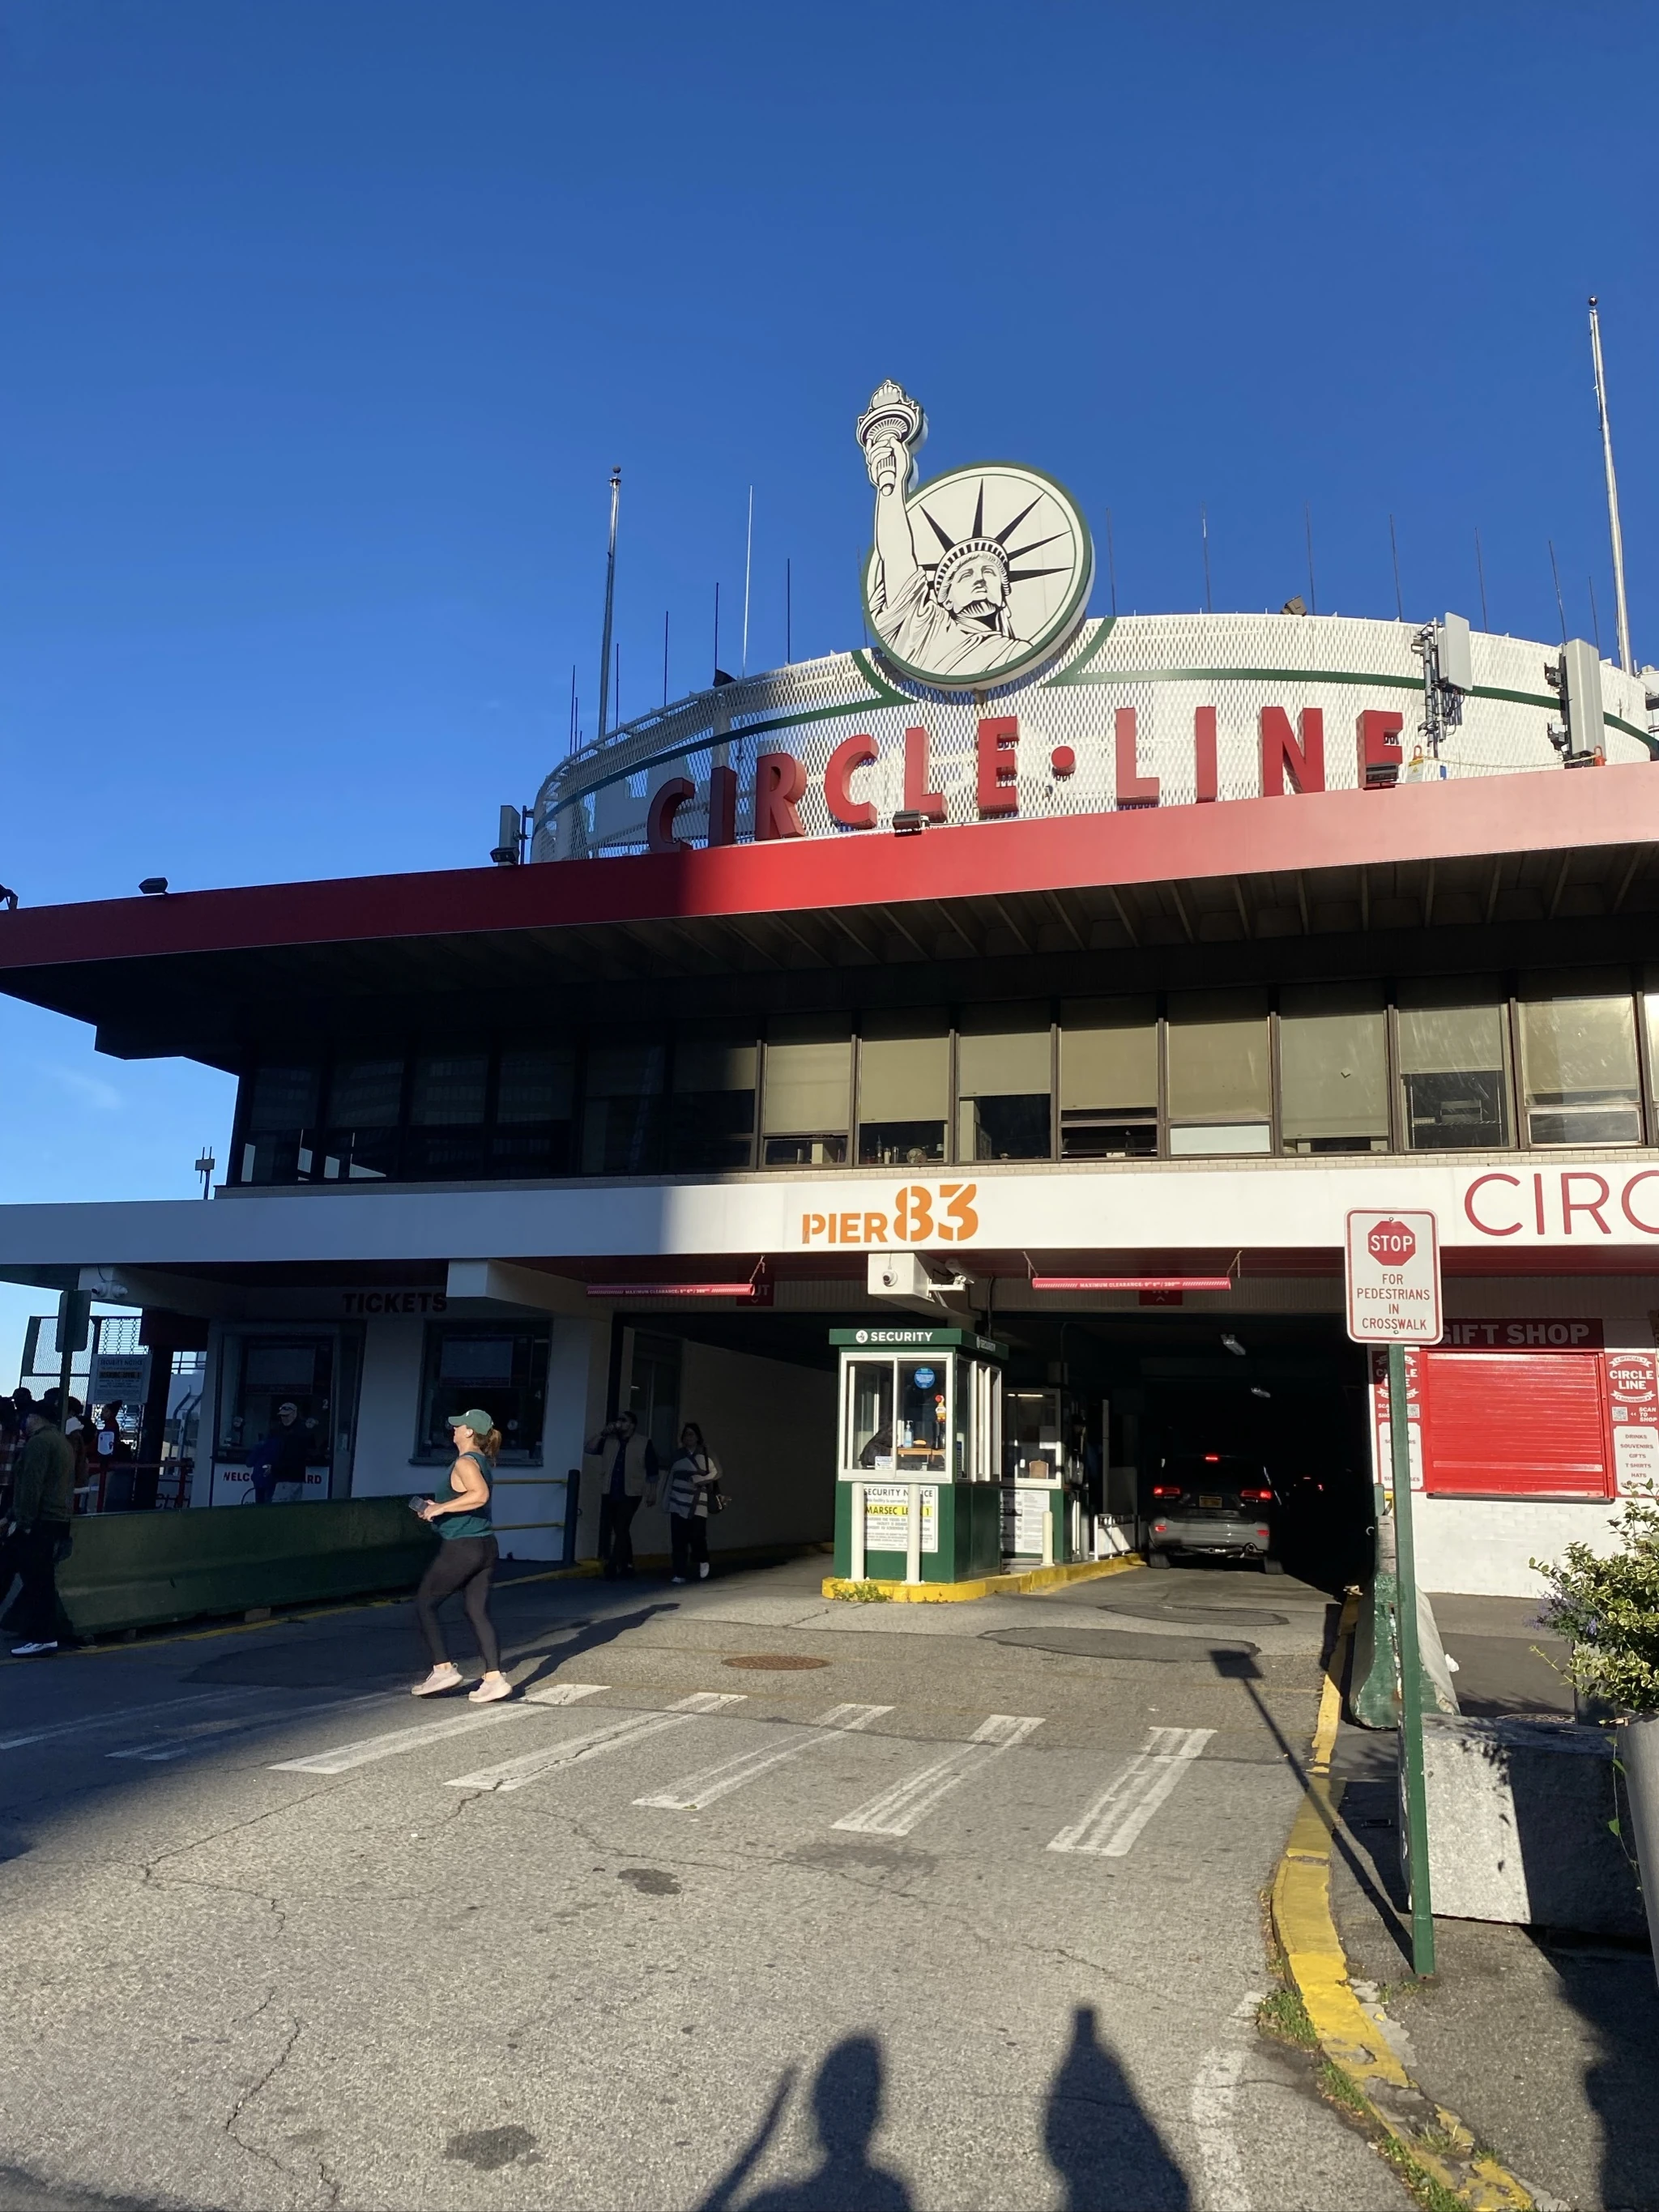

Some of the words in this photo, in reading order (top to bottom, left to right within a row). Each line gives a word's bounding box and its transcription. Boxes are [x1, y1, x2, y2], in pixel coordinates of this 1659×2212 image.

[648, 716, 1020, 853] CIRCLE
[1115, 705, 1403, 804] LINE
[802, 1213, 888, 1244] PIER
[893, 1184, 979, 1242] 83
[1371, 1235, 1413, 1251] STOP
[1382, 1274, 1403, 1285] FOR
[755, 1285, 770, 1296] UT
[1357, 1288, 1430, 1300] PEDESTRIANS
[342, 1293, 446, 1313] TICKETS
[1388, 1303, 1399, 1315] IN
[1363, 1318, 1427, 1330] CROSSWALK
[871, 1332, 933, 1342] SECURITY
[1507, 1323, 1589, 1345] SHOP
[1609, 1370, 1654, 1379] CIRCLE
[1618, 1380, 1646, 1390] LINE
[322, 1398, 329, 1409] 2
[865, 1507, 898, 1515] MARSEC
